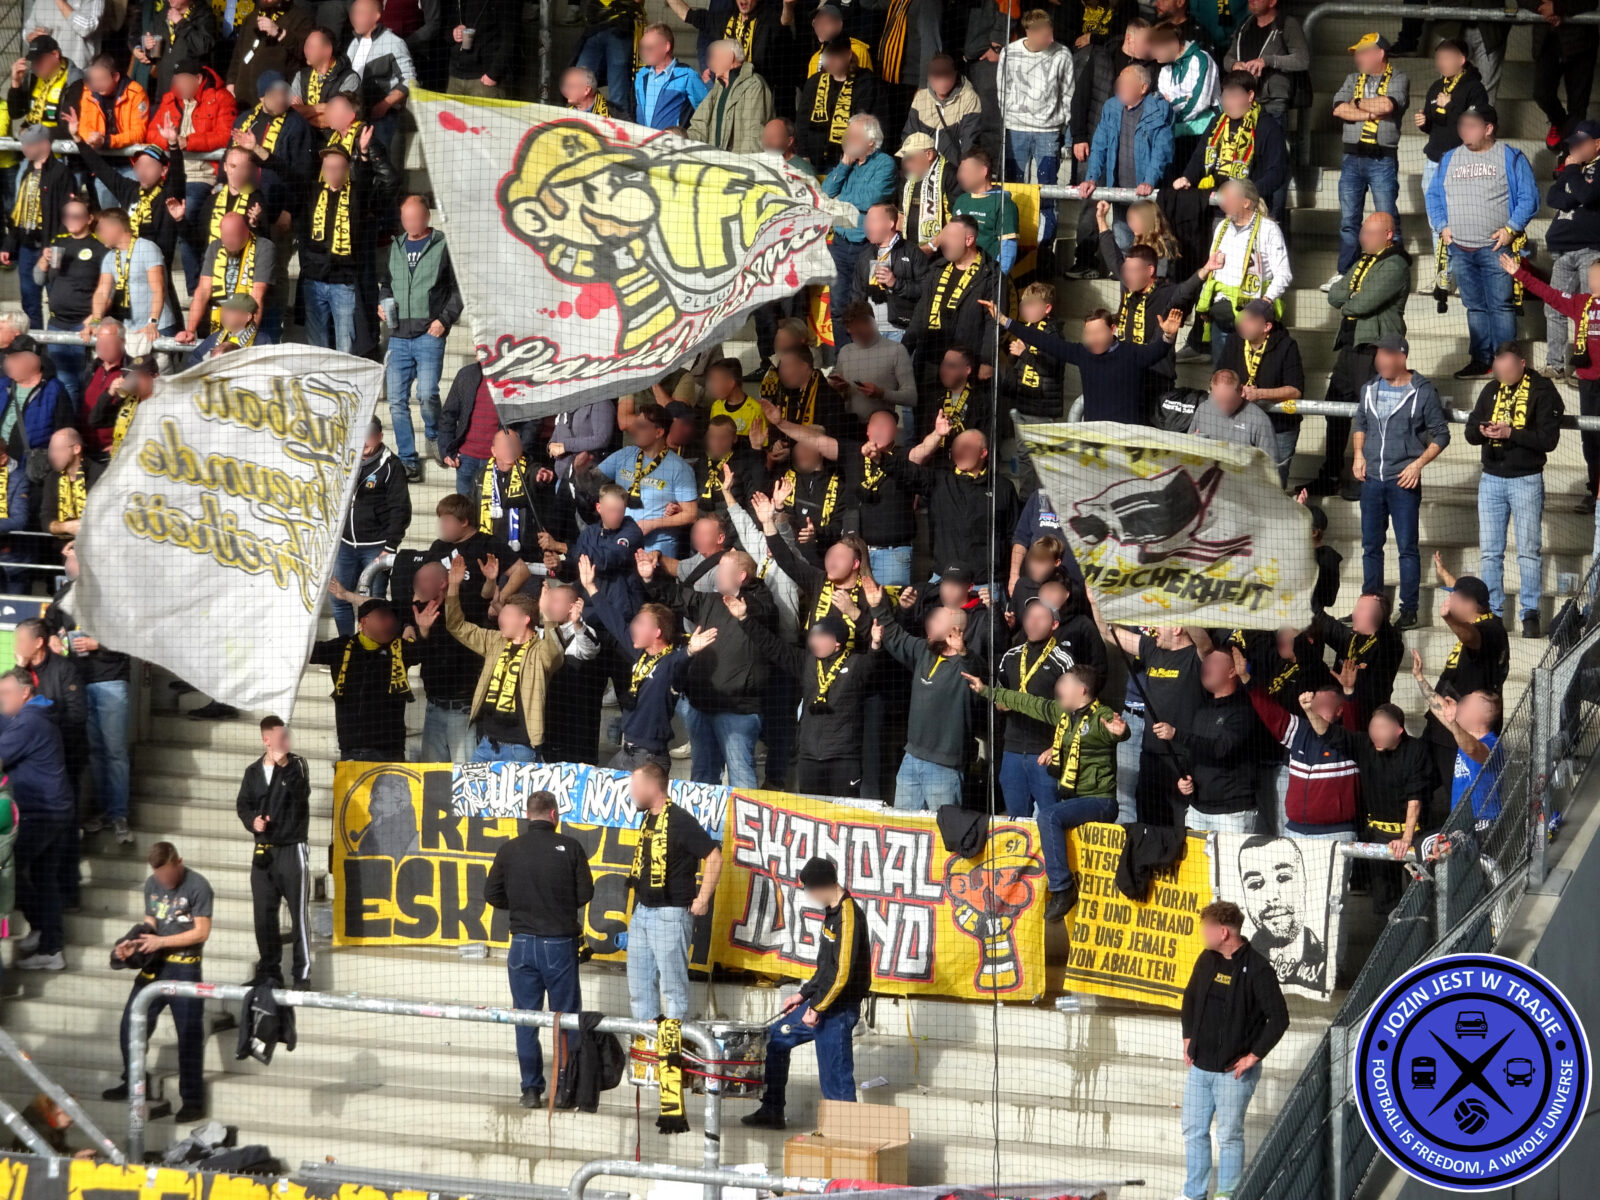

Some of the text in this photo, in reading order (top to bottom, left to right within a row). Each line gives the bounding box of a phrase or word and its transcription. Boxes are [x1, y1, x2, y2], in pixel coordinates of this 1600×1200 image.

[1154, 885, 1201, 914] VORAN.
[732, 873, 934, 980] JUGND
[1103, 902, 1132, 925] UND
[1136, 907, 1194, 936] NIEMAND
[1095, 926, 1124, 949] UNS
[1127, 931, 1177, 959] JEMALS
[1100, 952, 1177, 983] ABHALTEN!
